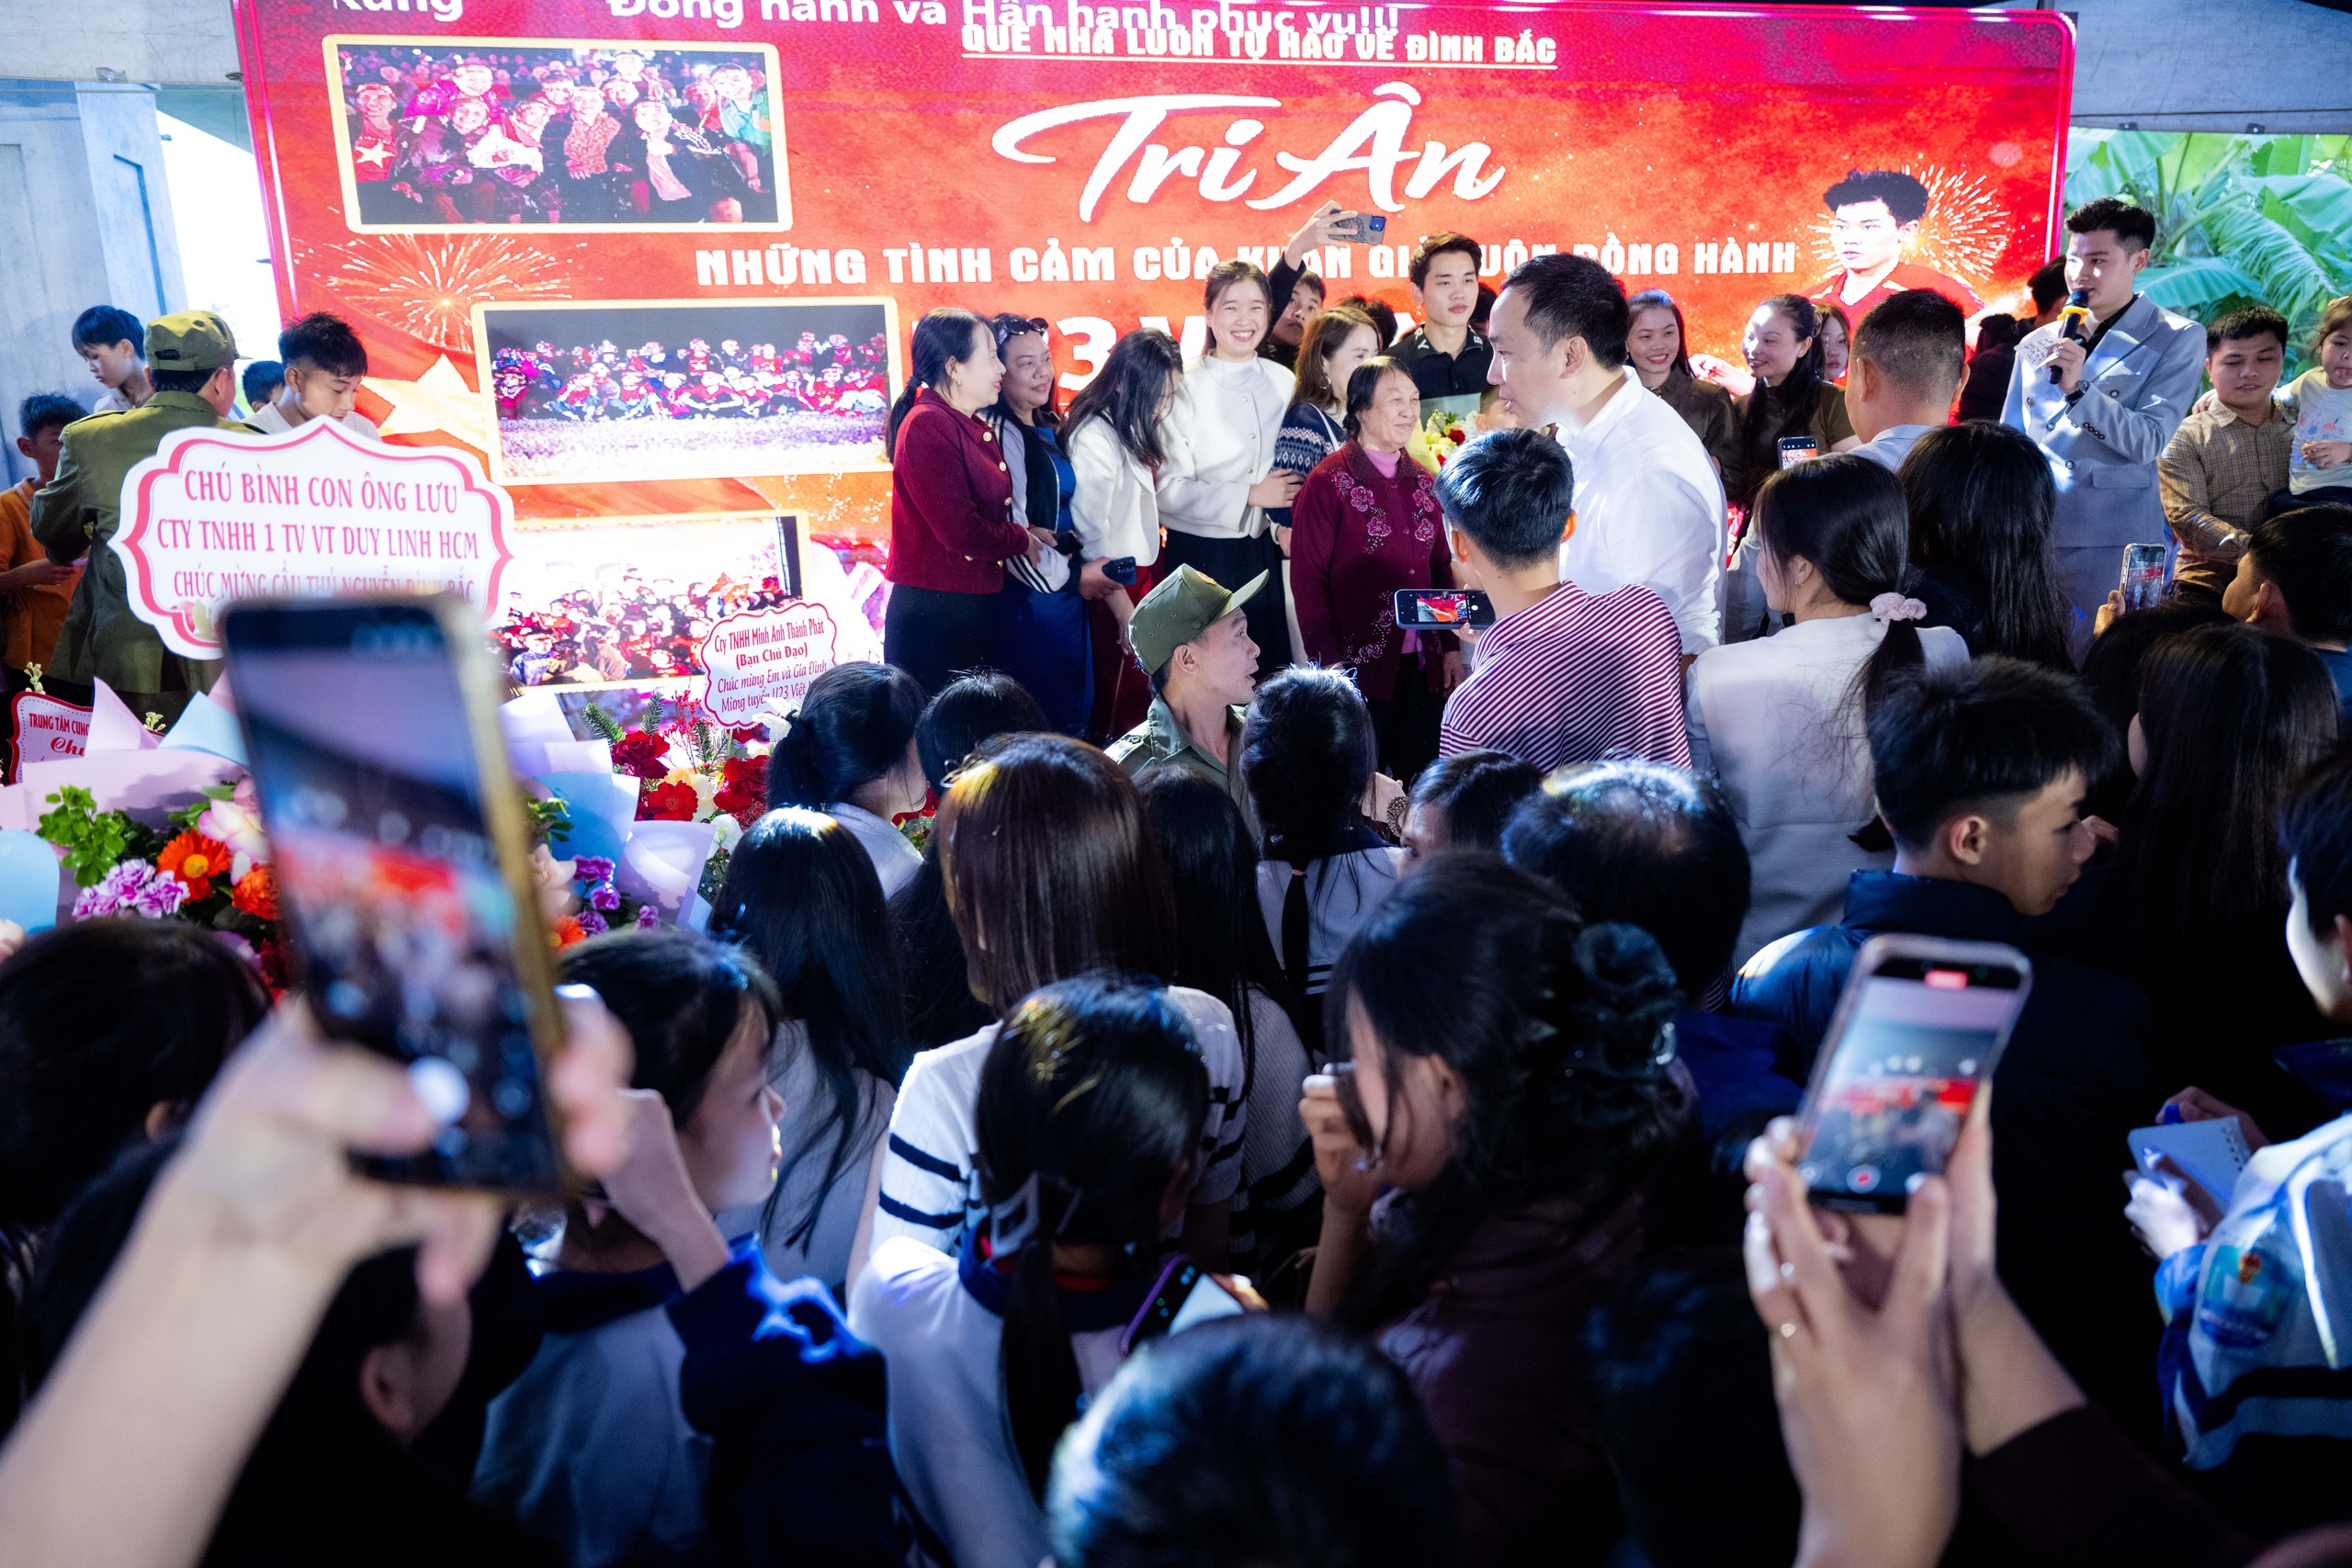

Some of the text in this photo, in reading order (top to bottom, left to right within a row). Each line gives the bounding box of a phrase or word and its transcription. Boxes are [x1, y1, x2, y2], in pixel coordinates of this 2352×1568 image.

[1405, 30, 1484, 62] ĐÌNH
[1494, 28, 1557, 63] BẮC
[991, 82, 1507, 222] Tri Ân
[695, 243, 866, 286] NHỮNG
[883, 243, 992, 283] TÌNH
[1009, 237, 1115, 282] CẢM
[1133, 237, 1220, 280] CỦA
[1368, 236, 1429, 277] GI
[1694, 239, 1796, 274] HÀNH
[184, 462, 458, 513] CHÚ BÌNH CON ÔNG LƯU
[157, 519, 480, 560] CTY TNHH 1 TV VT DUY LINH HCM
[174, 563, 216, 599] CHÚC
[220, 564, 266, 599] MỪNG
[715, 618, 824, 655] Cty TNHH Minh Anh Thành Phát
[718, 677, 739, 694] Chúc
[767, 670, 780, 683] Em
[782, 666, 791, 680] và
[794, 663, 807, 678] Gia
[721, 696, 745, 713] Mừng
[28, 713, 53, 730] TRUNG
[55, 715, 70, 733] TÂM
